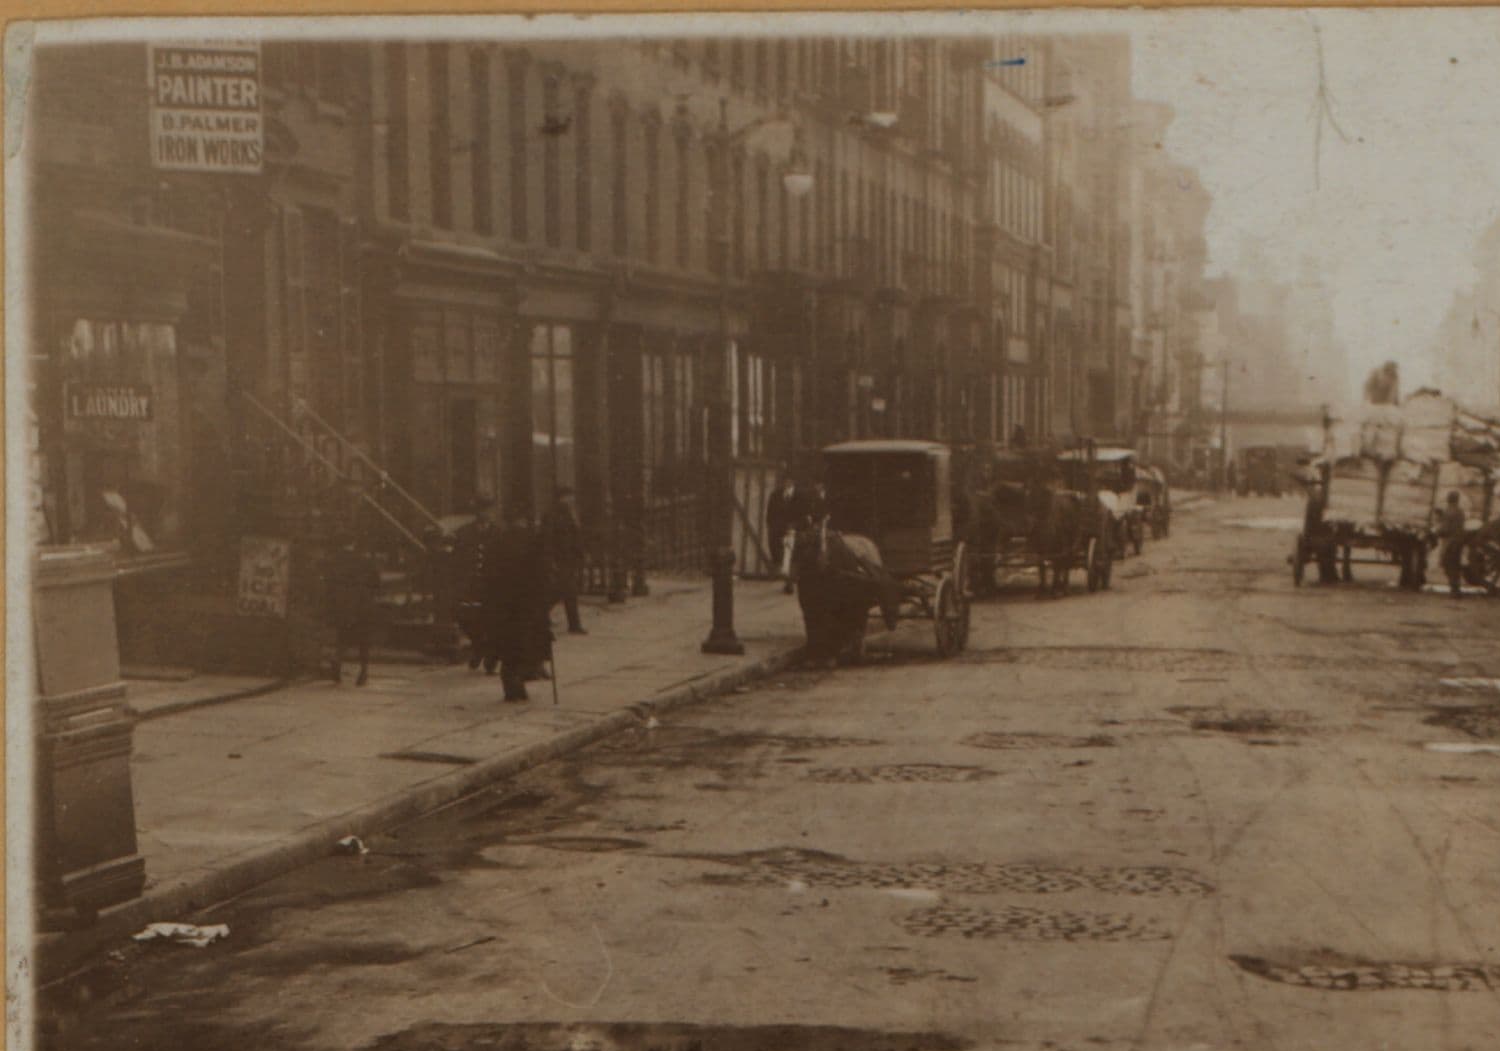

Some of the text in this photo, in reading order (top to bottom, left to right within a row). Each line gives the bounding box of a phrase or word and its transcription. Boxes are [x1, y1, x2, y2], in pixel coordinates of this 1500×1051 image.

[158, 74, 257, 107] PAINTER
[158, 136, 262, 167] IRON WORKS
[72, 394, 149, 418] LAUNDRY
